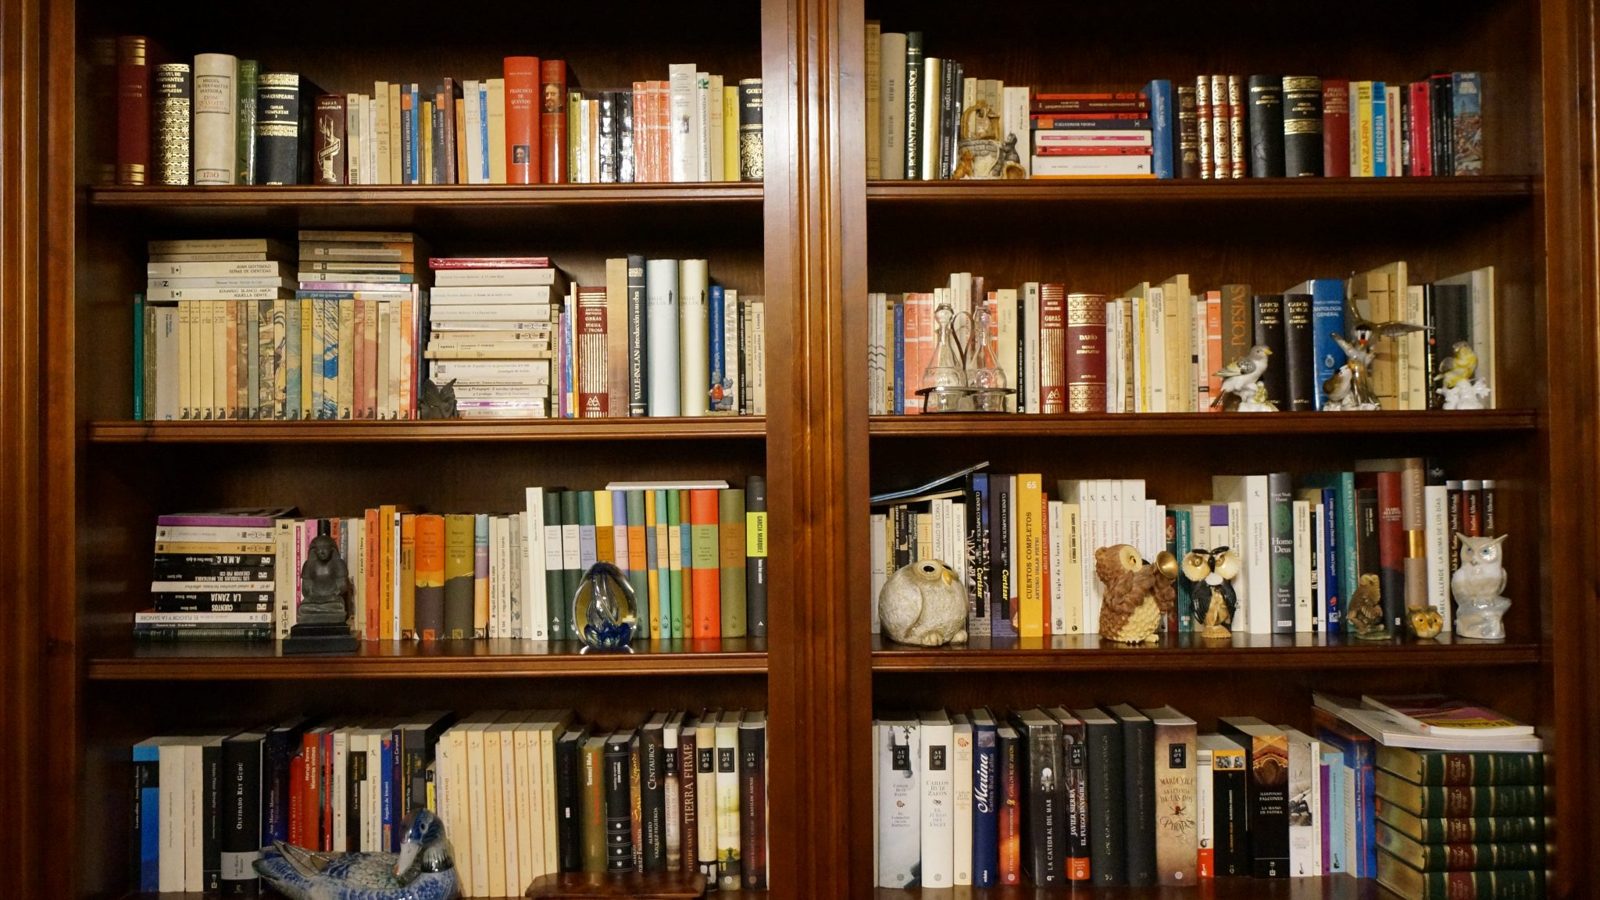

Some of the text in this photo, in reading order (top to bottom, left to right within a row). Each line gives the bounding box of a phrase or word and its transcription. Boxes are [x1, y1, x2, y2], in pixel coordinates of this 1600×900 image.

[908, 68, 917, 102] ESPAÑOL
[1375, 115, 1384, 162] MISERICORDIA
[1232, 286, 1246, 346] POESIAS
[1274, 545, 1291, 554] Deus
[210, 593, 241, 602] LA ZANJA
[647, 743, 657, 789] CENTAUROS
[683, 744, 694, 824] TIERRA FIRME
[975, 753, 989, 813] Marina
[1069, 789, 1077, 836] JAVIER SIERRA
[1079, 837, 1086, 846] EL
[1046, 862, 1053, 870] LA
